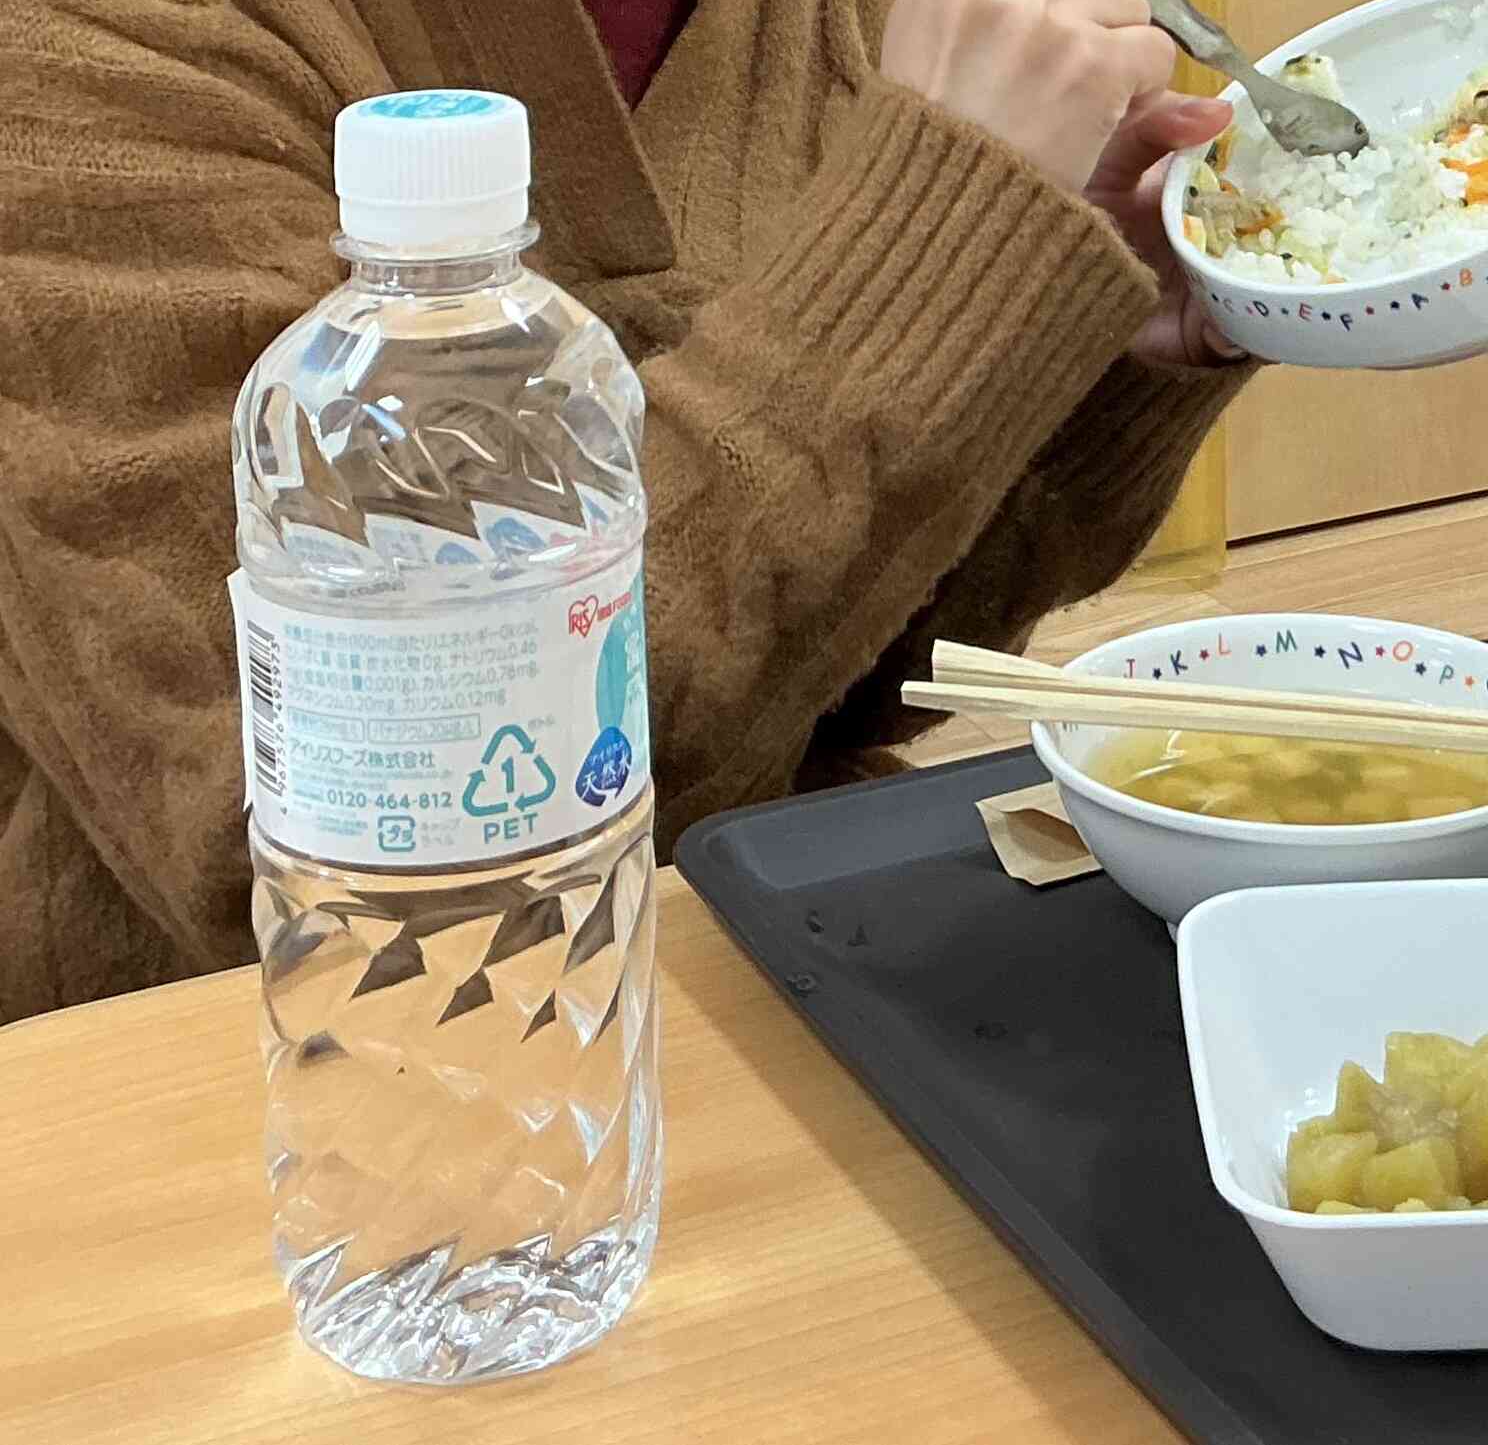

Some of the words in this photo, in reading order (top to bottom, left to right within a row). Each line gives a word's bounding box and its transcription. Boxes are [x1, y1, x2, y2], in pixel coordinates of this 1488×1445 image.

[1253, 301, 1269, 317] D
[1299, 303, 1312, 321] E
[1340, 314, 1352, 331] F
[1412, 294, 1428, 310] A
[1459, 268, 1473, 287] B
[1171, 651, 1188, 675] K
[1218, 634, 1232, 656] L
[1276, 630, 1297, 653] M
[1338, 642, 1363, 669] N
[1392, 641, 1413, 662] O
[1439, 665, 1454, 684] P
[484, 813, 539, 844] PET
